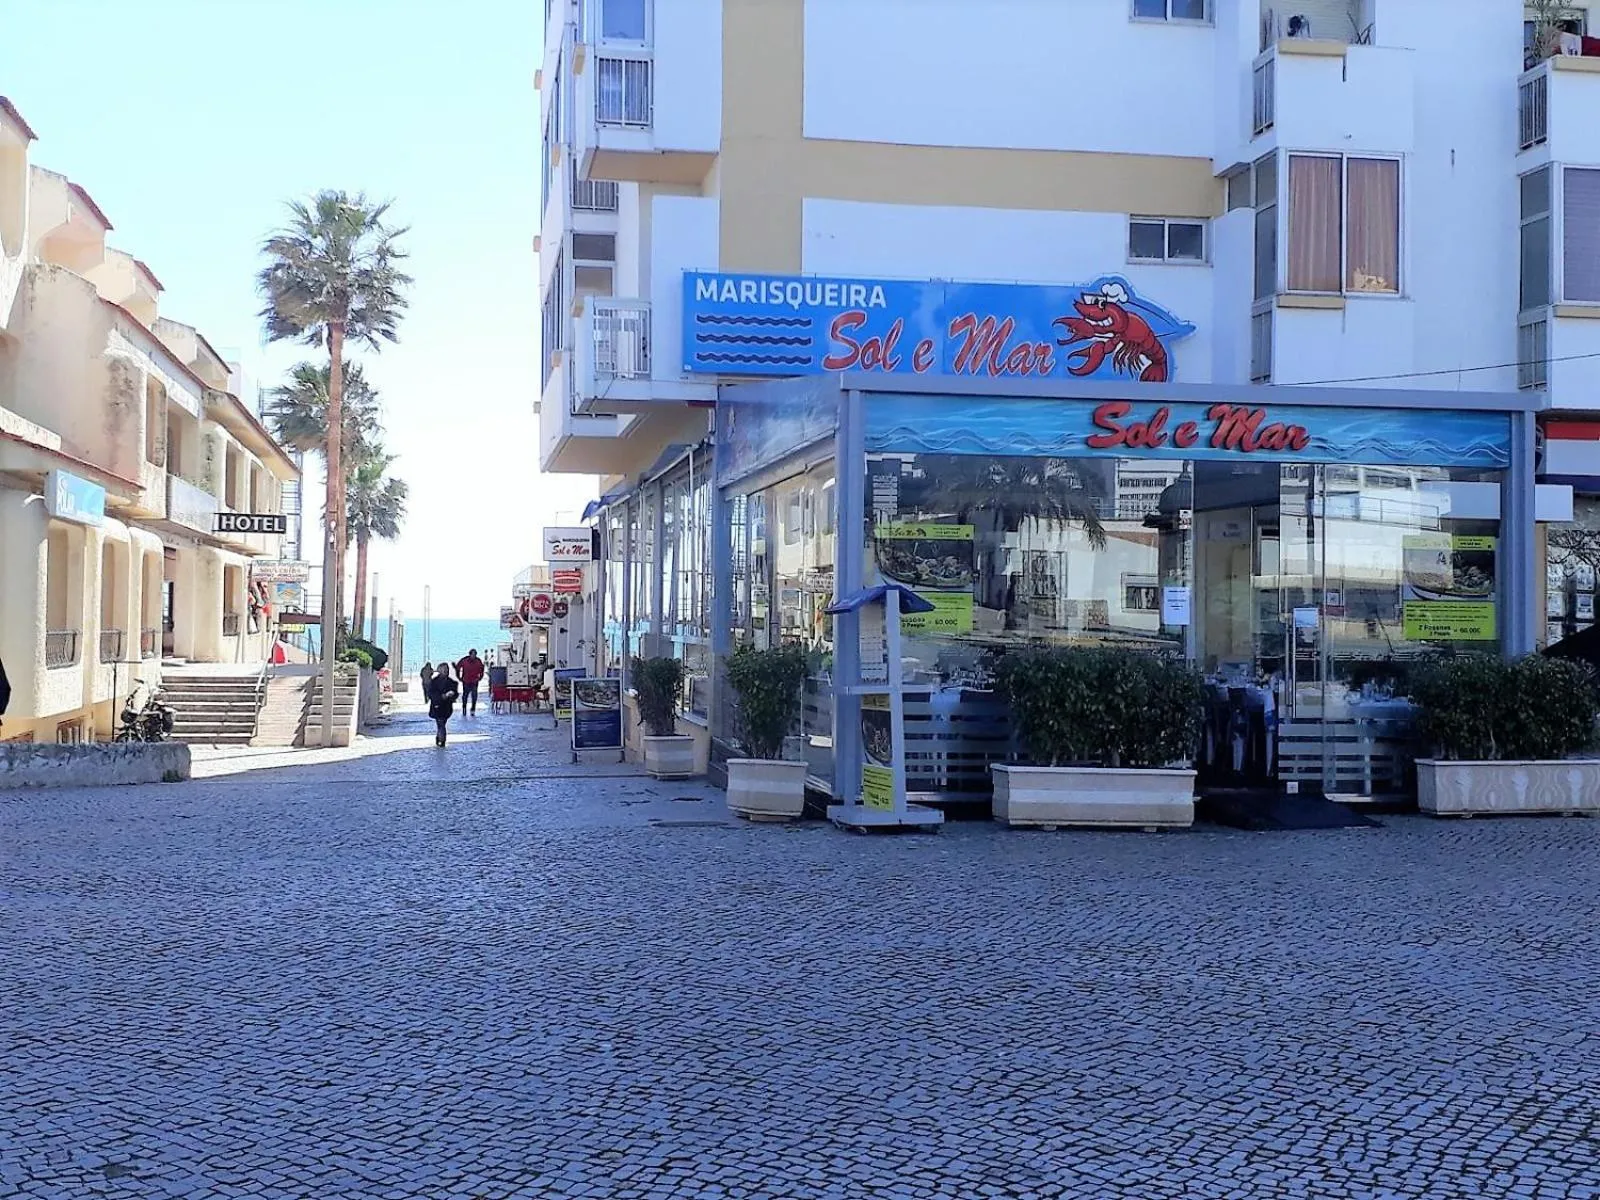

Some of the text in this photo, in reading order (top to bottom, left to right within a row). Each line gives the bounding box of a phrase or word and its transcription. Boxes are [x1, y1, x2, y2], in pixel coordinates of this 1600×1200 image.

[695, 277, 888, 310] MARISQUEIRA
[822, 309, 1056, 377] Sol e Mar
[1086, 401, 1311, 452] Sol e Mar
[221, 515, 285, 532] HOTEL
